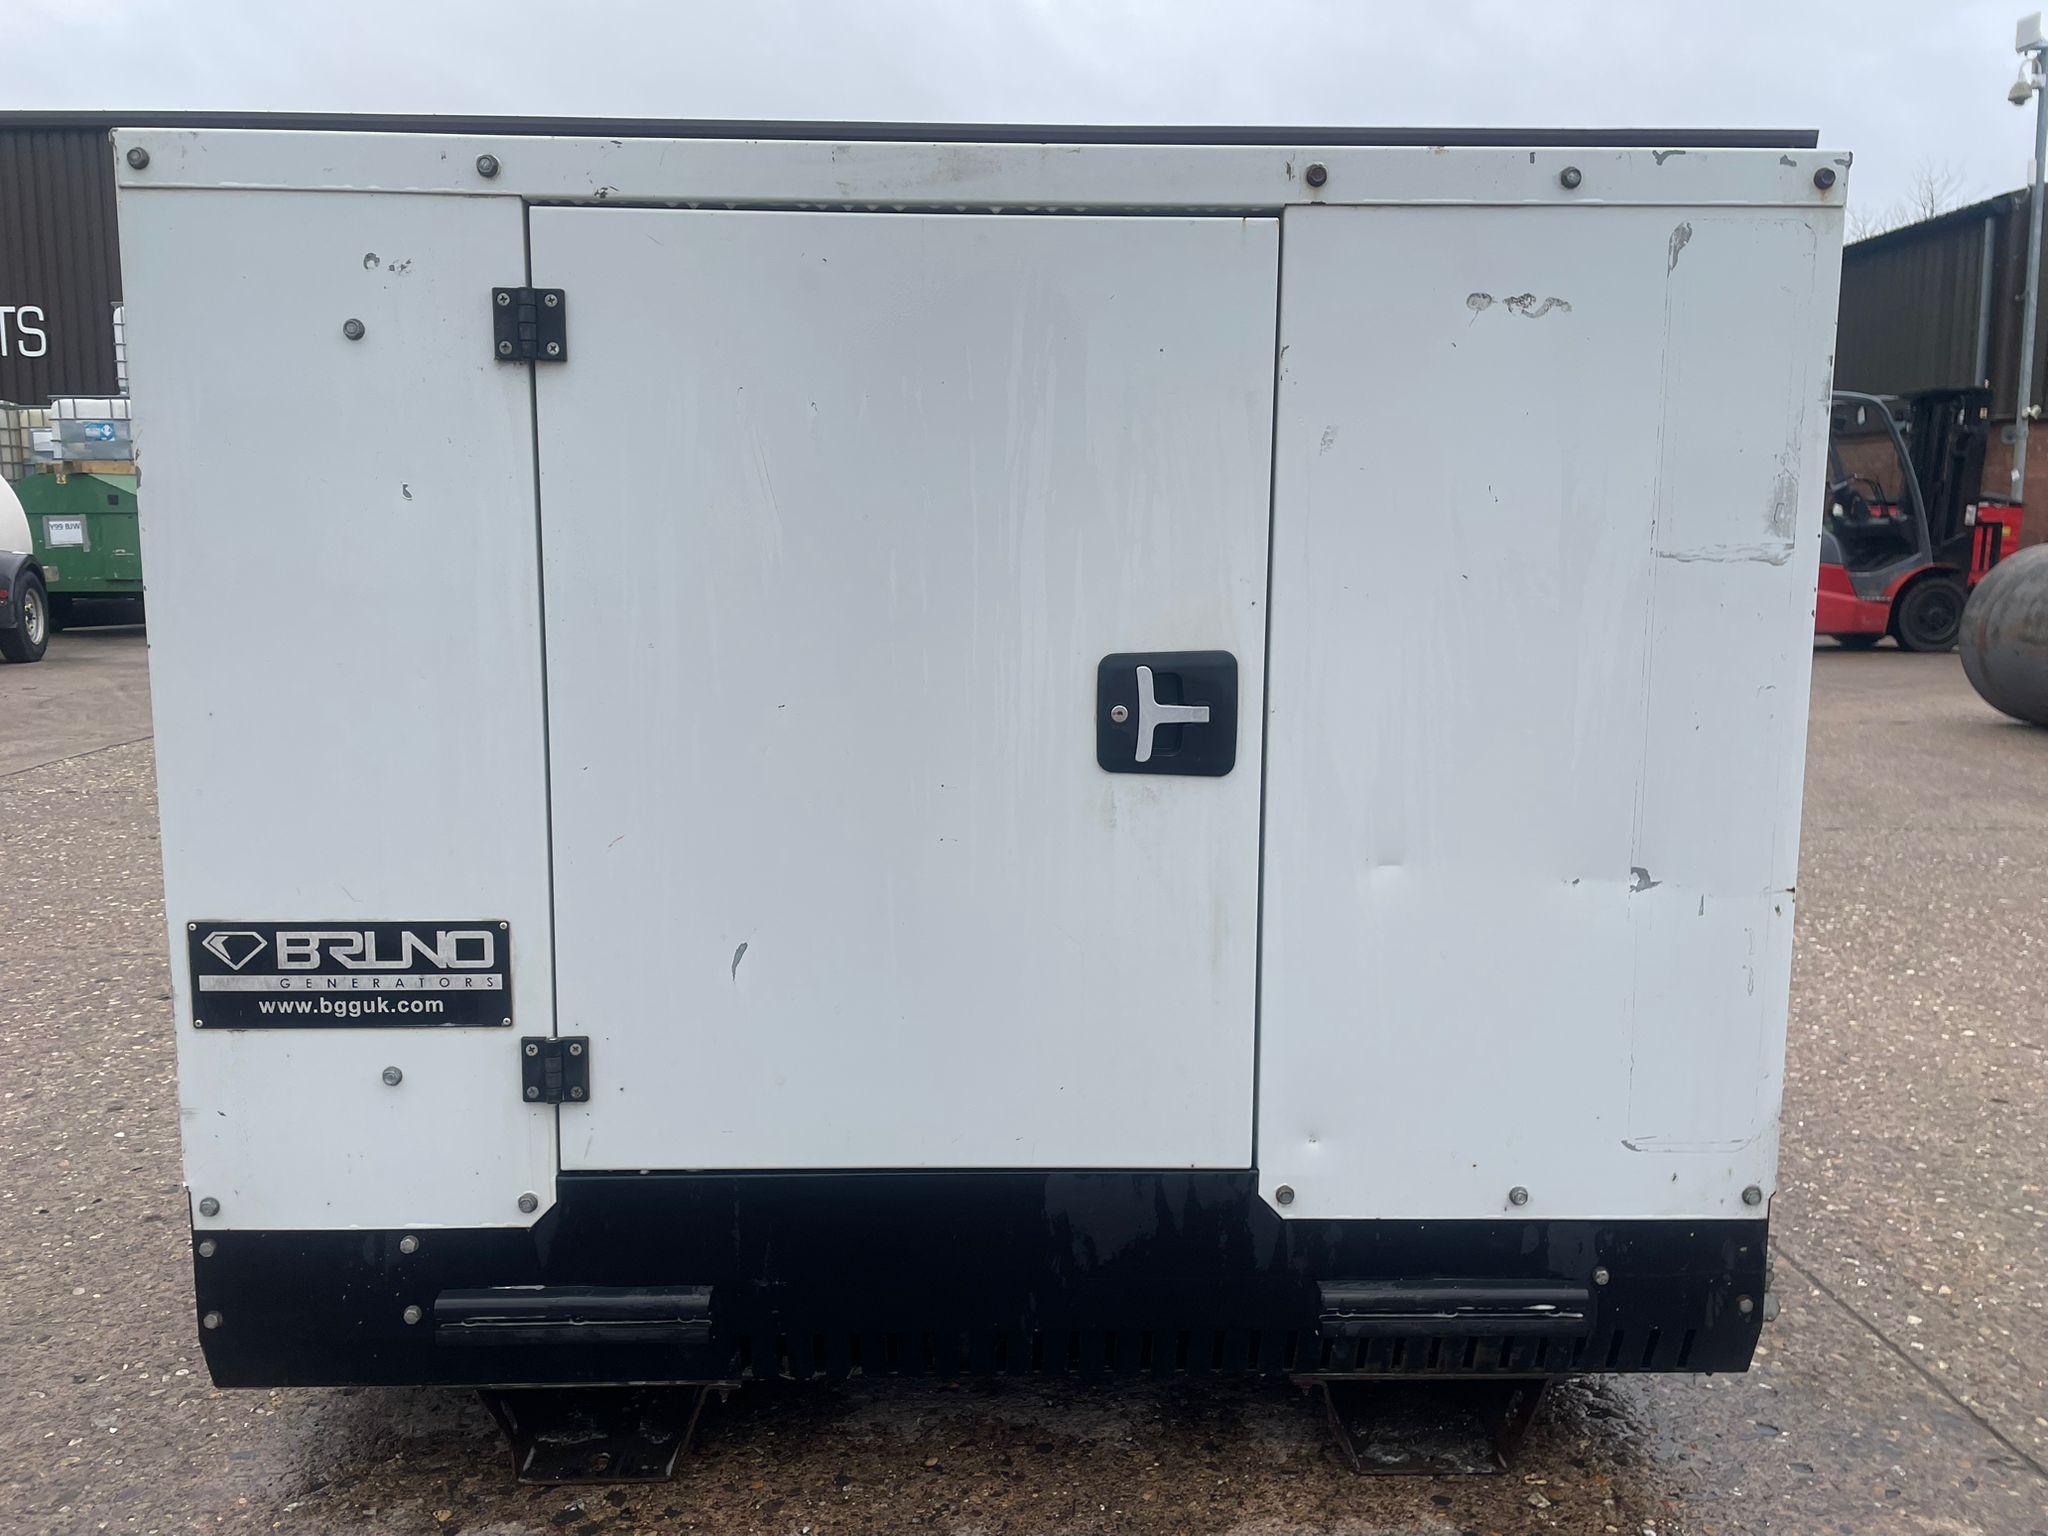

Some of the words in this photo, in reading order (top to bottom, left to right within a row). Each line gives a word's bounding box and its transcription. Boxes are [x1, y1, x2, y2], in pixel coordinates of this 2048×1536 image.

[276, 930, 495, 969] BRUNO
[280, 976, 494, 990] GENERATORS
[258, 997, 444, 1018] www.bgguk.com
